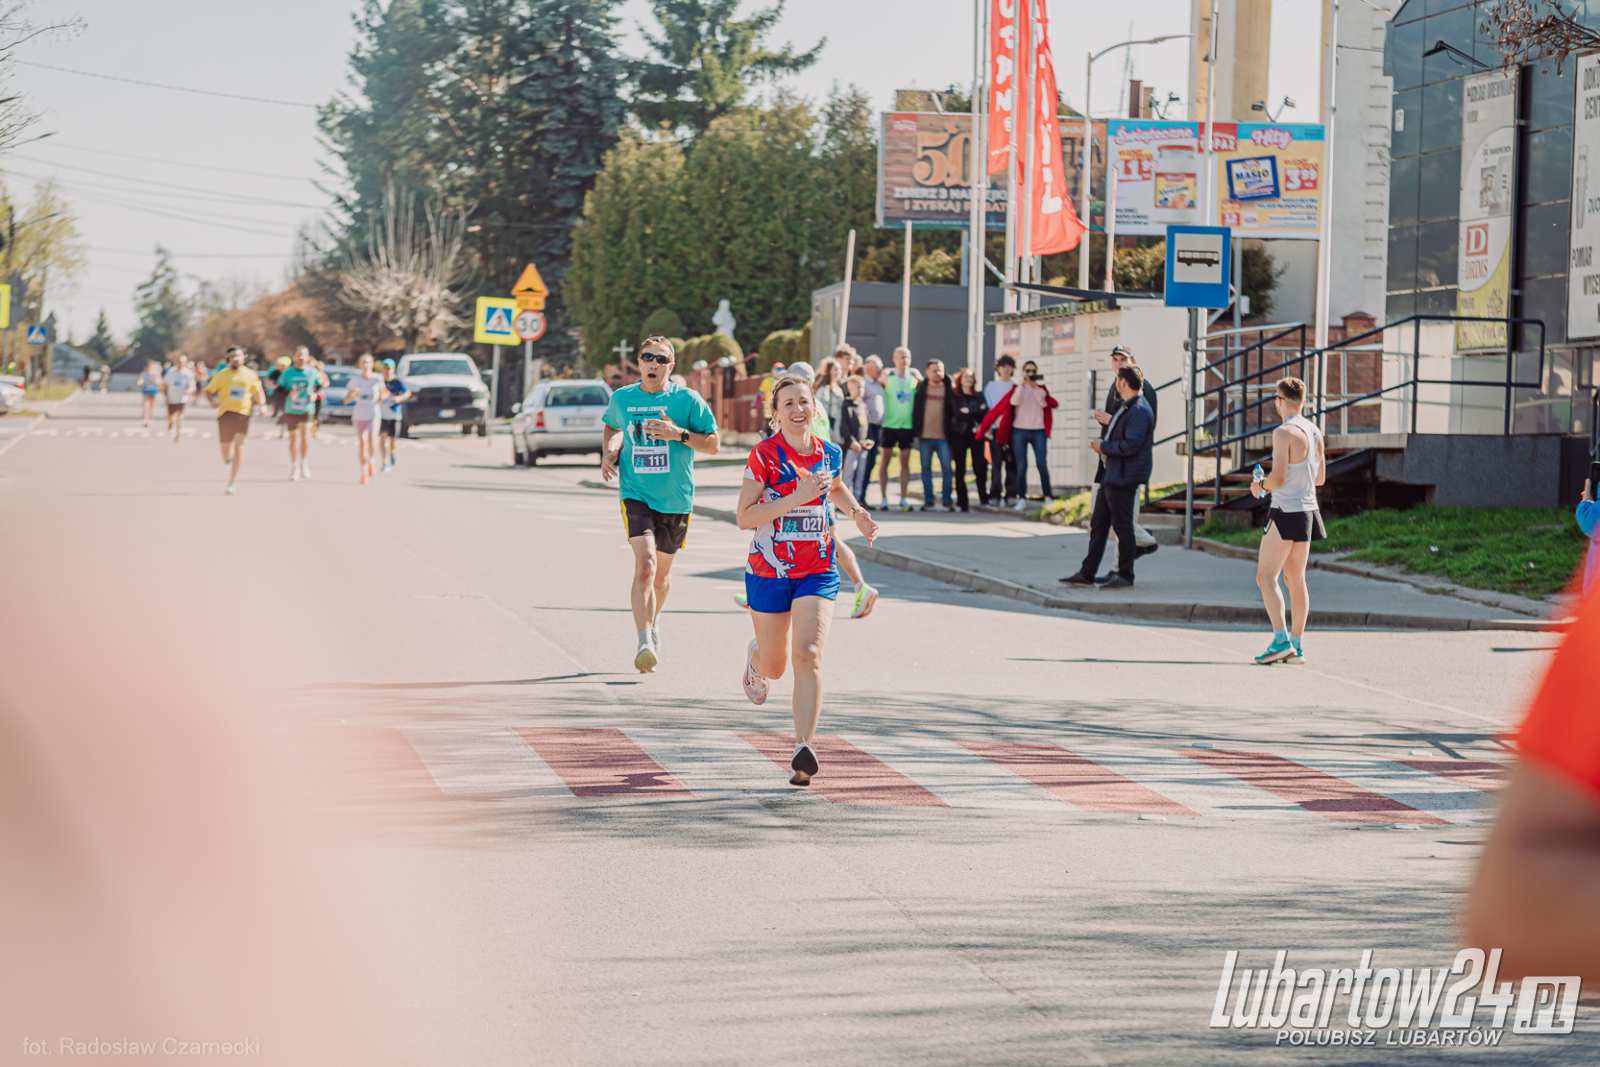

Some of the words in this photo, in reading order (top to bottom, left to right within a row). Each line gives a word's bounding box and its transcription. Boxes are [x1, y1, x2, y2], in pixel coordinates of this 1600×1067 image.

[519, 317, 539, 333] 30
[648, 455, 665, 466] 111
[802, 517, 822, 532] 027
